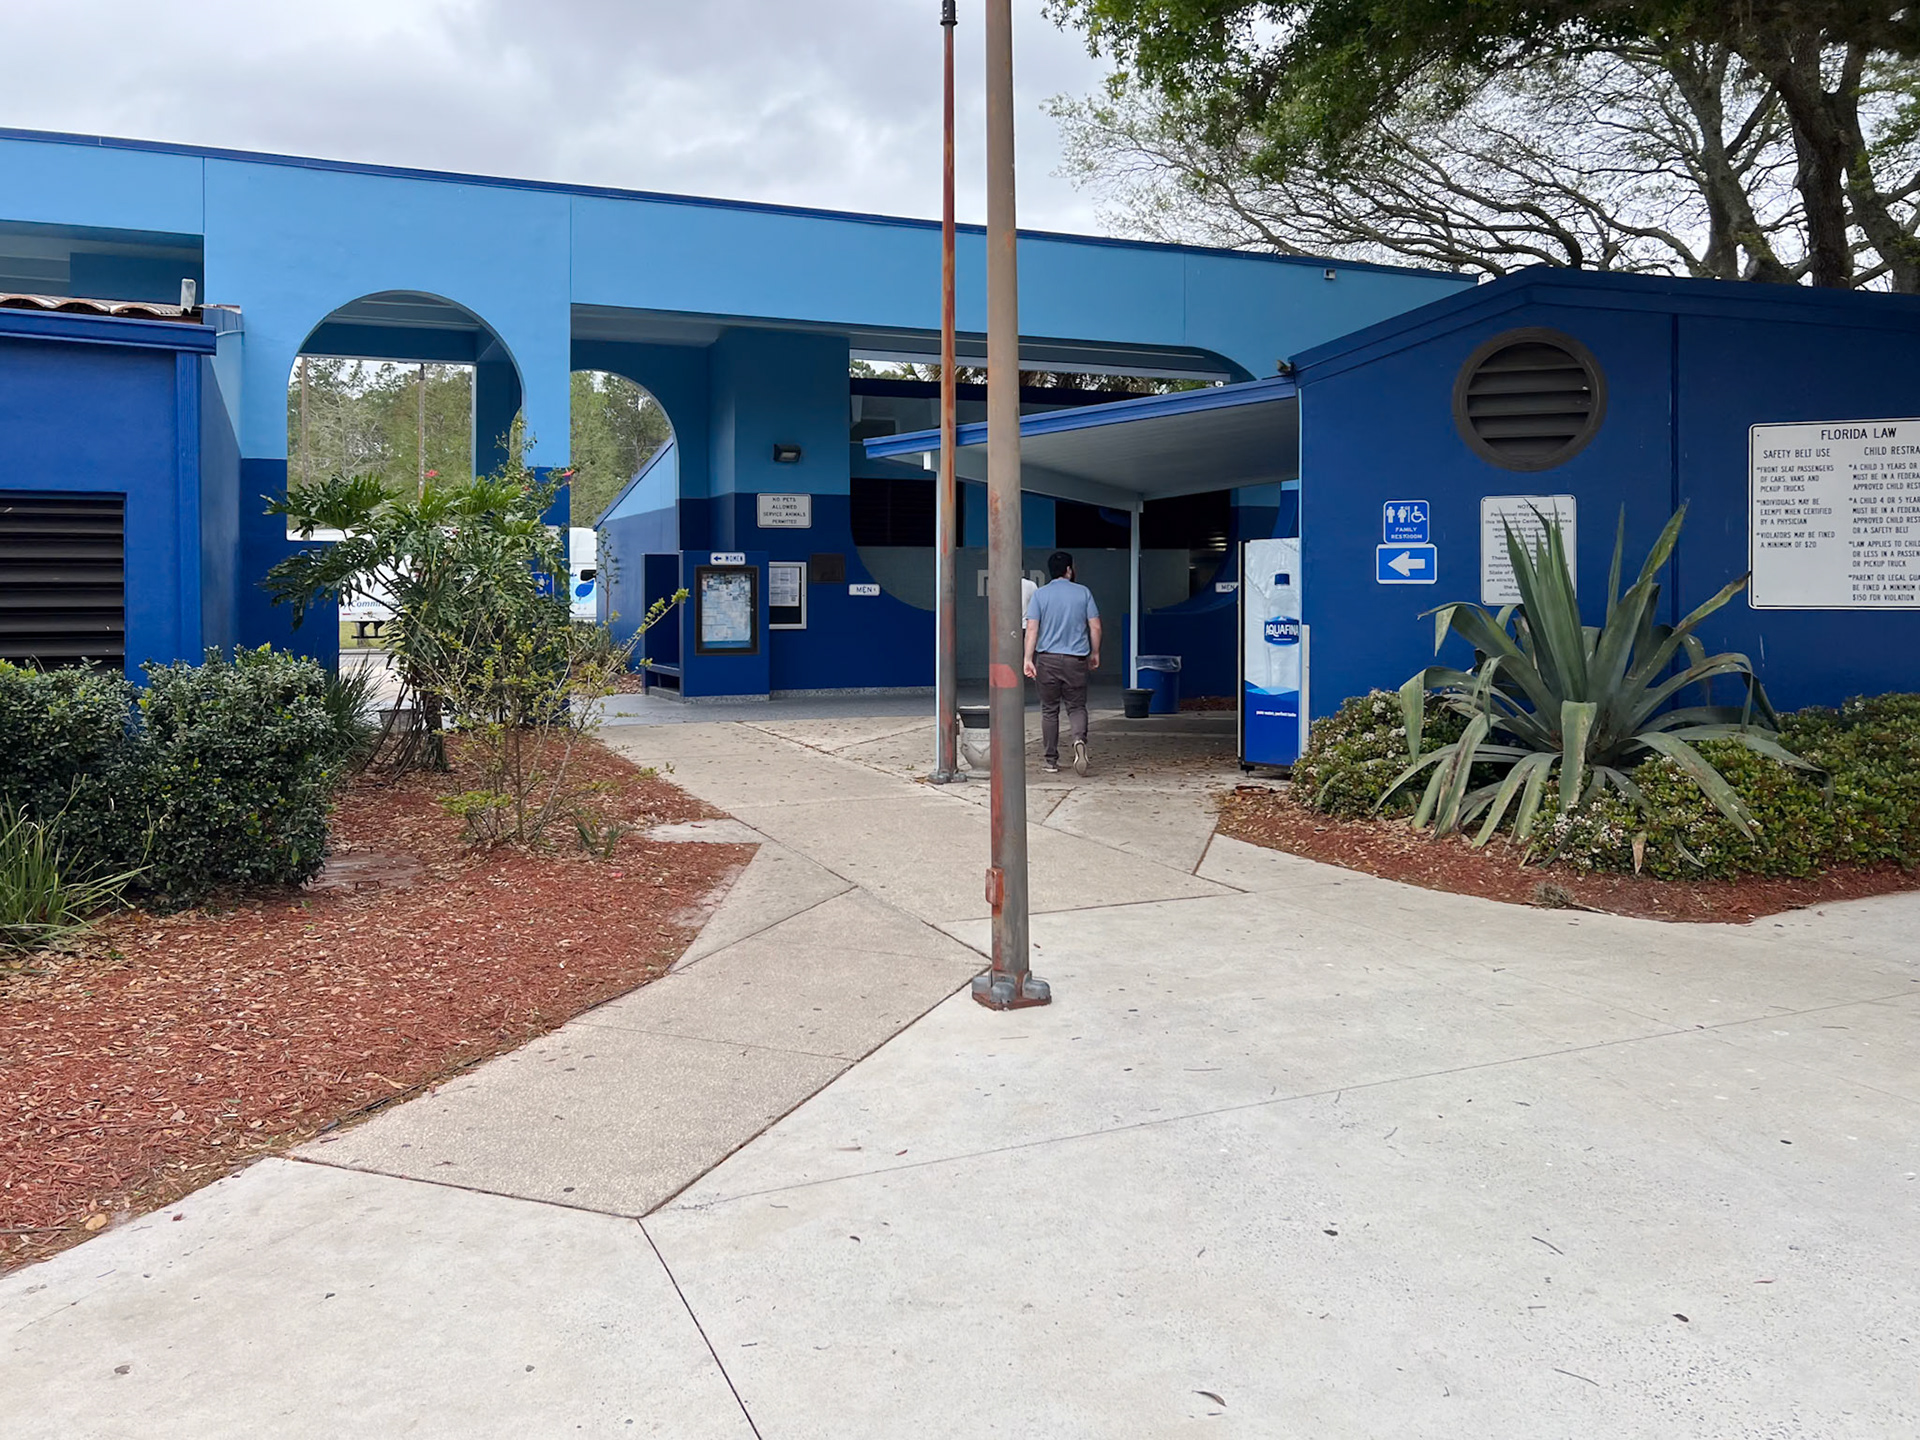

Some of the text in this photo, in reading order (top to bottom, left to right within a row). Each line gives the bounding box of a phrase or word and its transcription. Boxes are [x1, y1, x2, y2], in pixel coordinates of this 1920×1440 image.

[1821, 427, 1897, 441] FLORIDA LAW
[1763, 448, 1831, 459] SAFETY BELT USE
[1864, 446, 1887, 456] CHILD
[1797, 464, 1834, 472] PASSENGERS
[1887, 462, 1906, 470] YEARS
[1886, 482, 1904, 490] CHILD
[1812, 498, 1820, 506] BE
[1760, 508, 1782, 516] EXEMPT
[1886, 516, 1904, 524] CHILD
[1895, 526, 1909, 534] BELT
[1852, 540, 1865, 548] LAW
[1867, 540, 1892, 548] APPLIES
[1863, 550, 1878, 558] LESS
[1863, 560, 1885, 568] PICKUP
[1265, 624, 1299, 637] AQUAFINA
